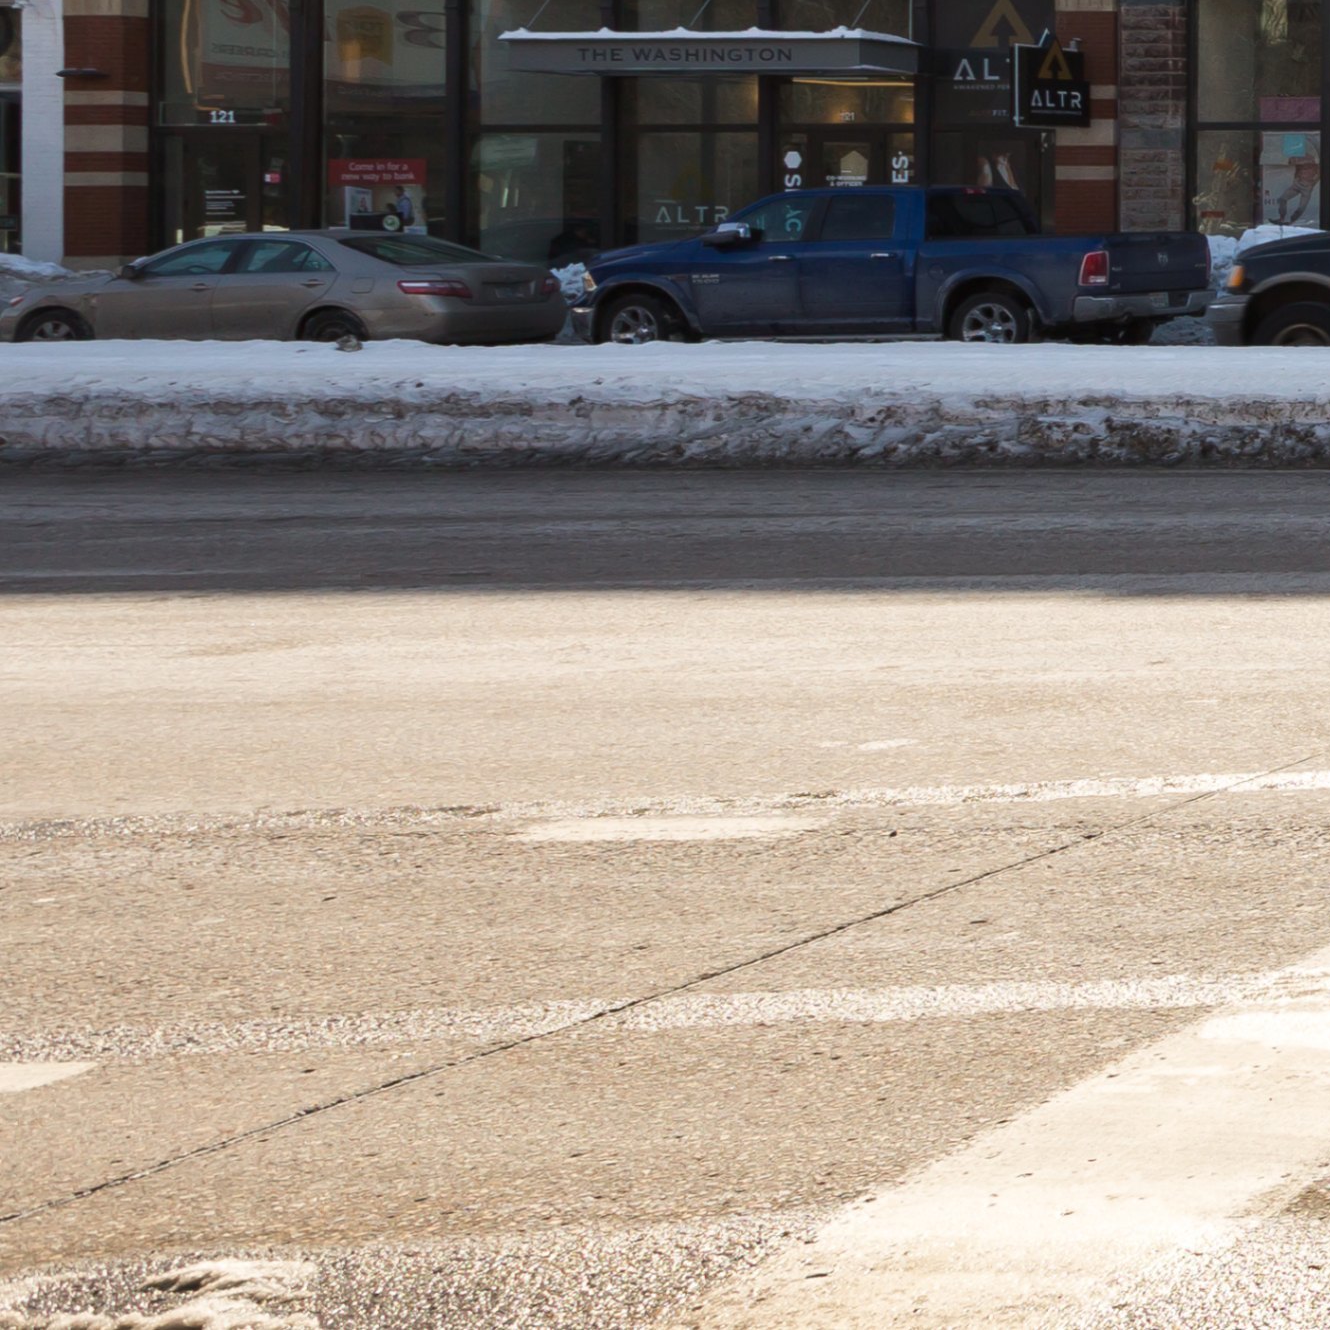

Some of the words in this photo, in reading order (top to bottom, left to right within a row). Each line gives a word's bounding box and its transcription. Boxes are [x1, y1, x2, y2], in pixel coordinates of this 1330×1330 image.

[577, 47, 624, 62] THE
[631, 47, 793, 62] WASHINGTON
[953, 57, 1010, 81] AL
[1030, 88, 1083, 110] ALTR
[209, 110, 237, 124] 121
[347, 161, 375, 171] Come
[376, 161, 385, 171] in
[386, 161, 400, 171] for
[393, 171, 415, 181] bank
[655, 205, 729, 224] ALTR
